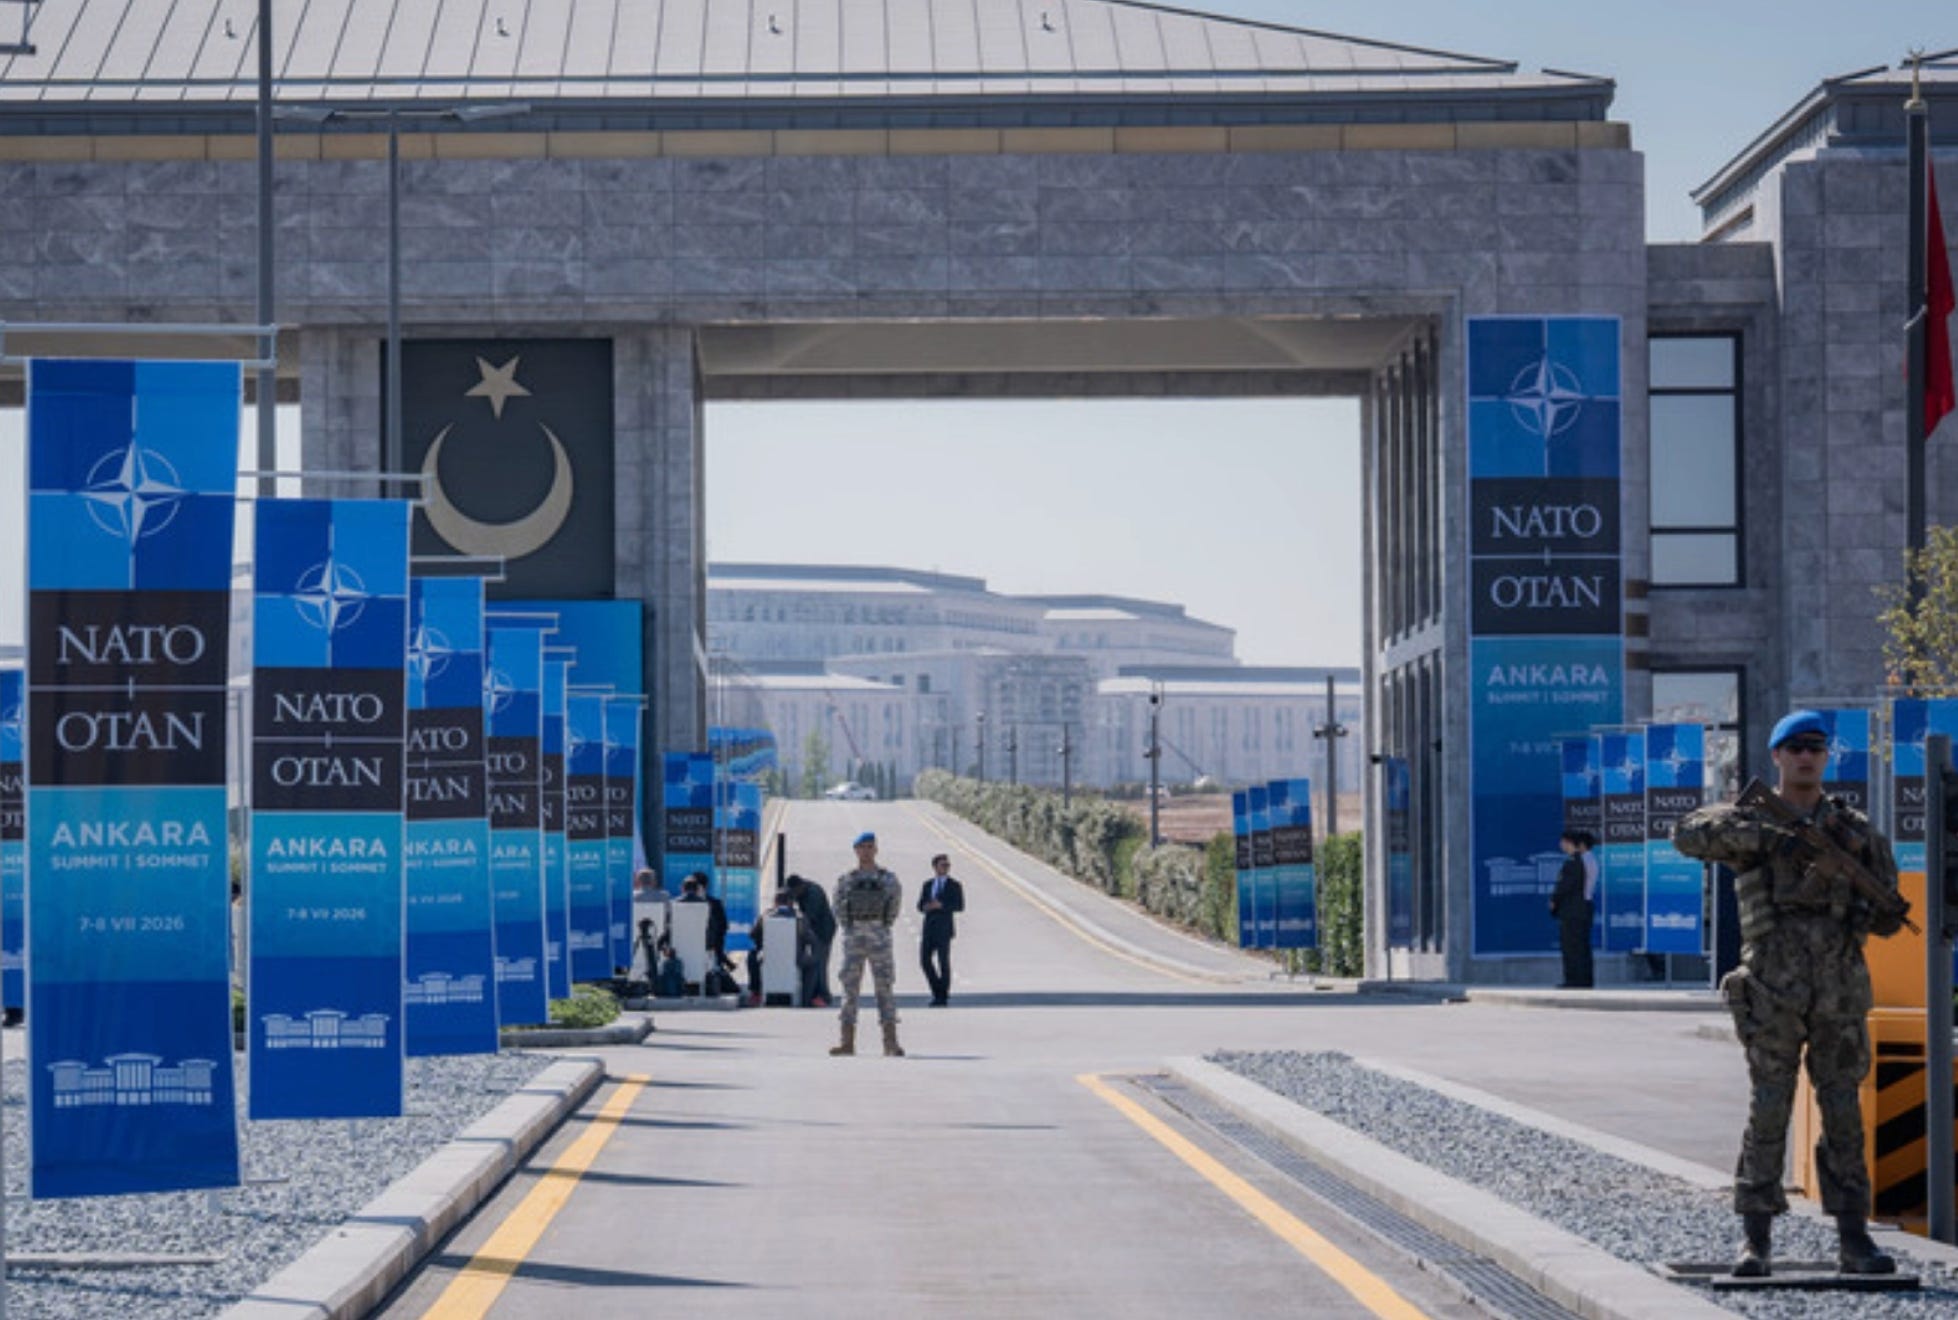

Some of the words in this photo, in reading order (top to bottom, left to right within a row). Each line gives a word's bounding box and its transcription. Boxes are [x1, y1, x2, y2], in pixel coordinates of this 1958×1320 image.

[1491, 504, 1602, 538] NATO
[1490, 576, 1604, 608] OTAN
[57, 624, 206, 666] NATO
[1487, 664, 1609, 686] ANKARA
[273, 693, 383, 723] NATO
[55, 711, 205, 751] OTAN
[407, 726, 468, 751] ATO
[271, 756, 383, 786] OTAN
[487, 752, 526, 773] TO
[407, 776, 468, 800] TAN
[568, 784, 597, 800] TO
[1903, 787, 1926, 802] NA
[487, 793, 526, 813] AN
[1655, 795, 1696, 808] NATO
[568, 814, 597, 829] AN
[1903, 816, 1926, 831] OT
[51, 821, 211, 847] ANKARA
[267, 838, 387, 858] ANKARA
[405, 838, 476, 855] NKARA
[493, 844, 530, 858] ARA
[51, 854, 118, 870] SUMMIT
[135, 853, 209, 868] SOMMET
[267, 863, 317, 873] SUMMIT
[330, 863, 387, 873] SOMMET
[111, 915, 137, 931] VII
[140, 915, 184, 931] 2026
